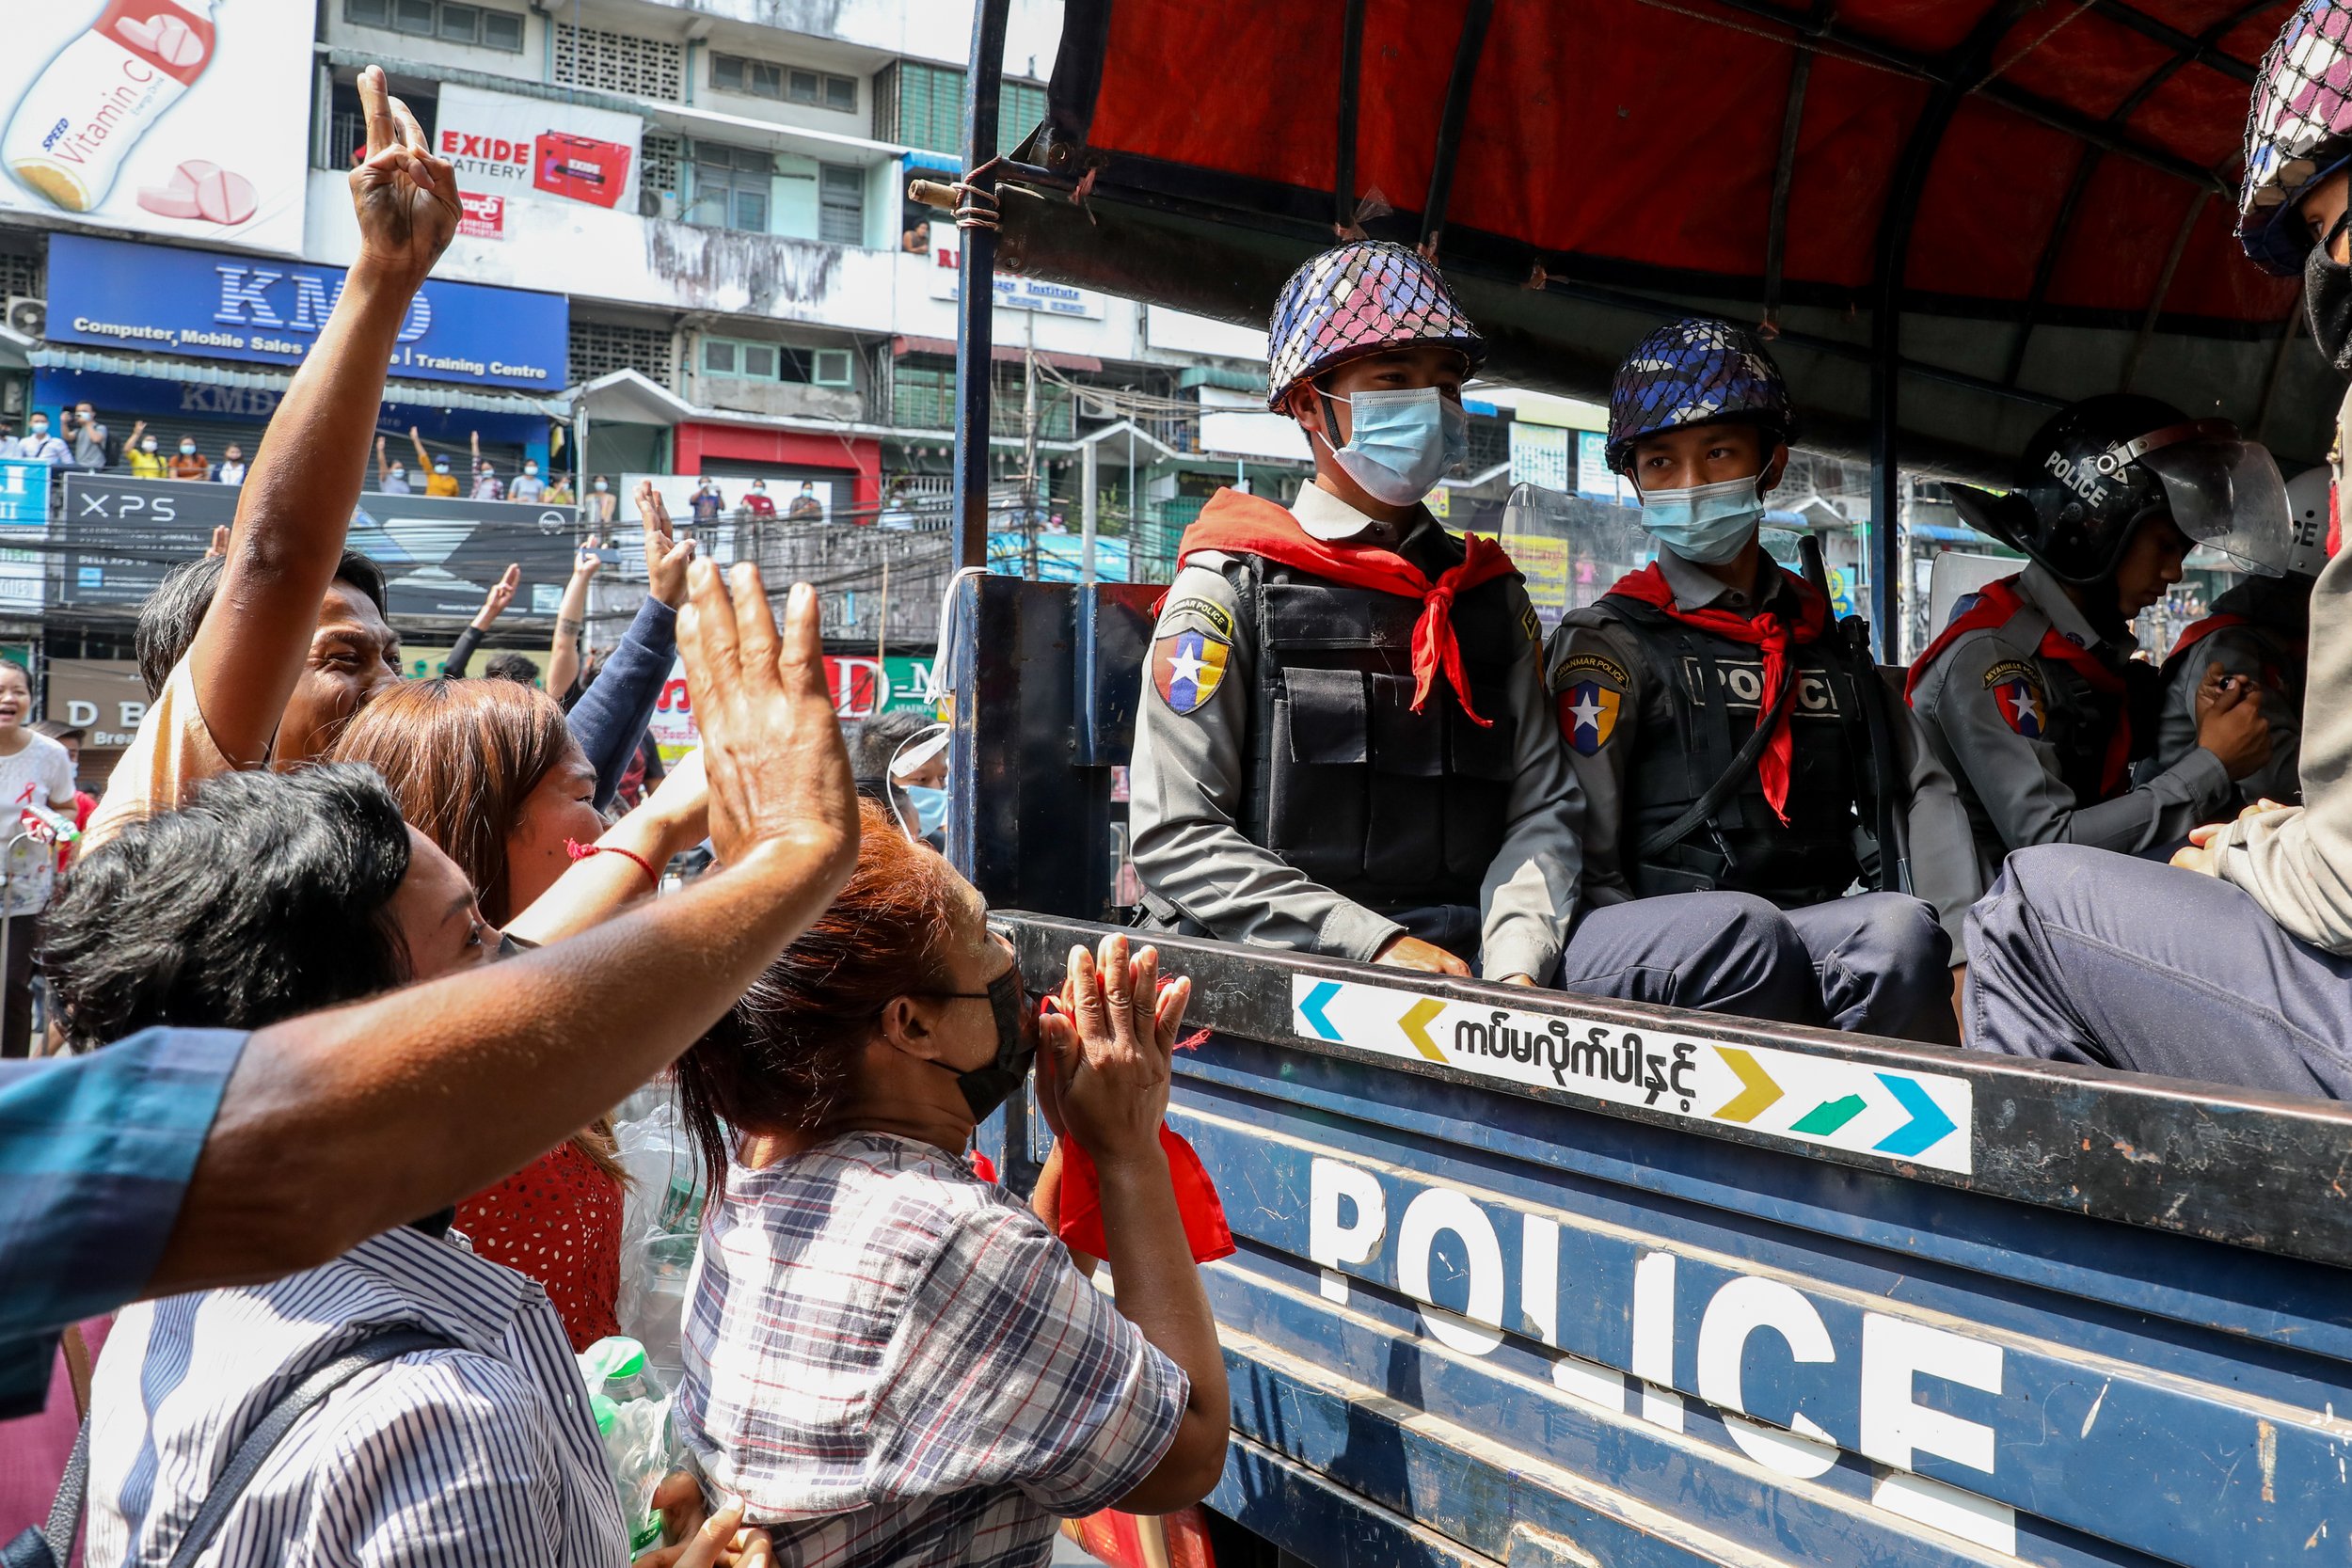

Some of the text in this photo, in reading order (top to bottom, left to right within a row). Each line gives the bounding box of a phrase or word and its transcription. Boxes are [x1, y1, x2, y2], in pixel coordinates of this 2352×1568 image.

[54, 59, 152, 164] Vitamin C
[42, 118, 69, 151] SPEED
[441, 130, 530, 166] EXIDE
[1027, 283, 1080, 301] Institute
[181, 329, 245, 349] Mobile
[250, 337, 303, 356] Sales
[416, 354, 485, 376] Training
[490, 361, 548, 379] Centre
[2044, 451, 2107, 508] POLICE
[80, 493, 176, 522] XPS
[1196, 601, 1225, 625] POLICE
[1556, 657, 1626, 684] MYANMAR POLICE
[1310, 1156, 2015, 1555] POLICE
